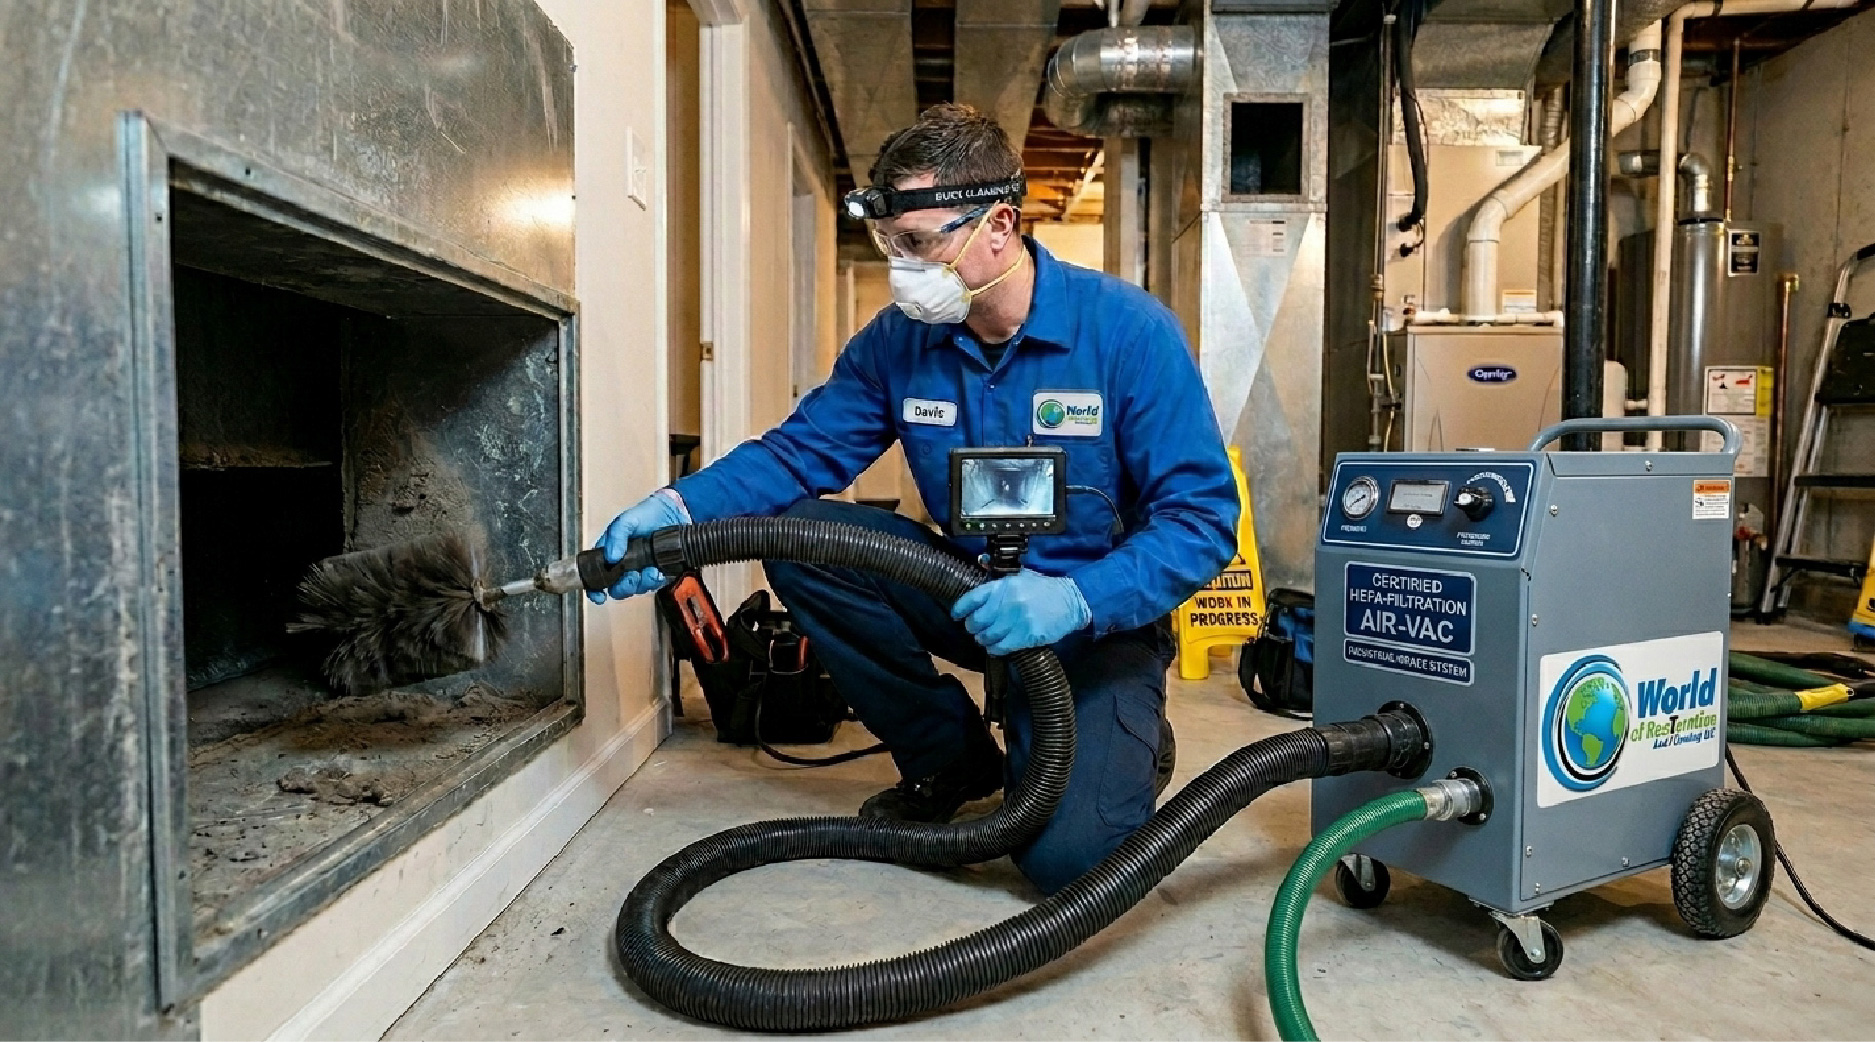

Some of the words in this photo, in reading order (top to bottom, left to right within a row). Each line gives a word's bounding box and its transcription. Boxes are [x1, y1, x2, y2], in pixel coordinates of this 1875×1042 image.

[914, 405, 945, 419] Davis
[1236, 596, 1251, 609] IN
[1359, 608, 1454, 643] AIR-VAC
[1637, 667, 1718, 719] World
